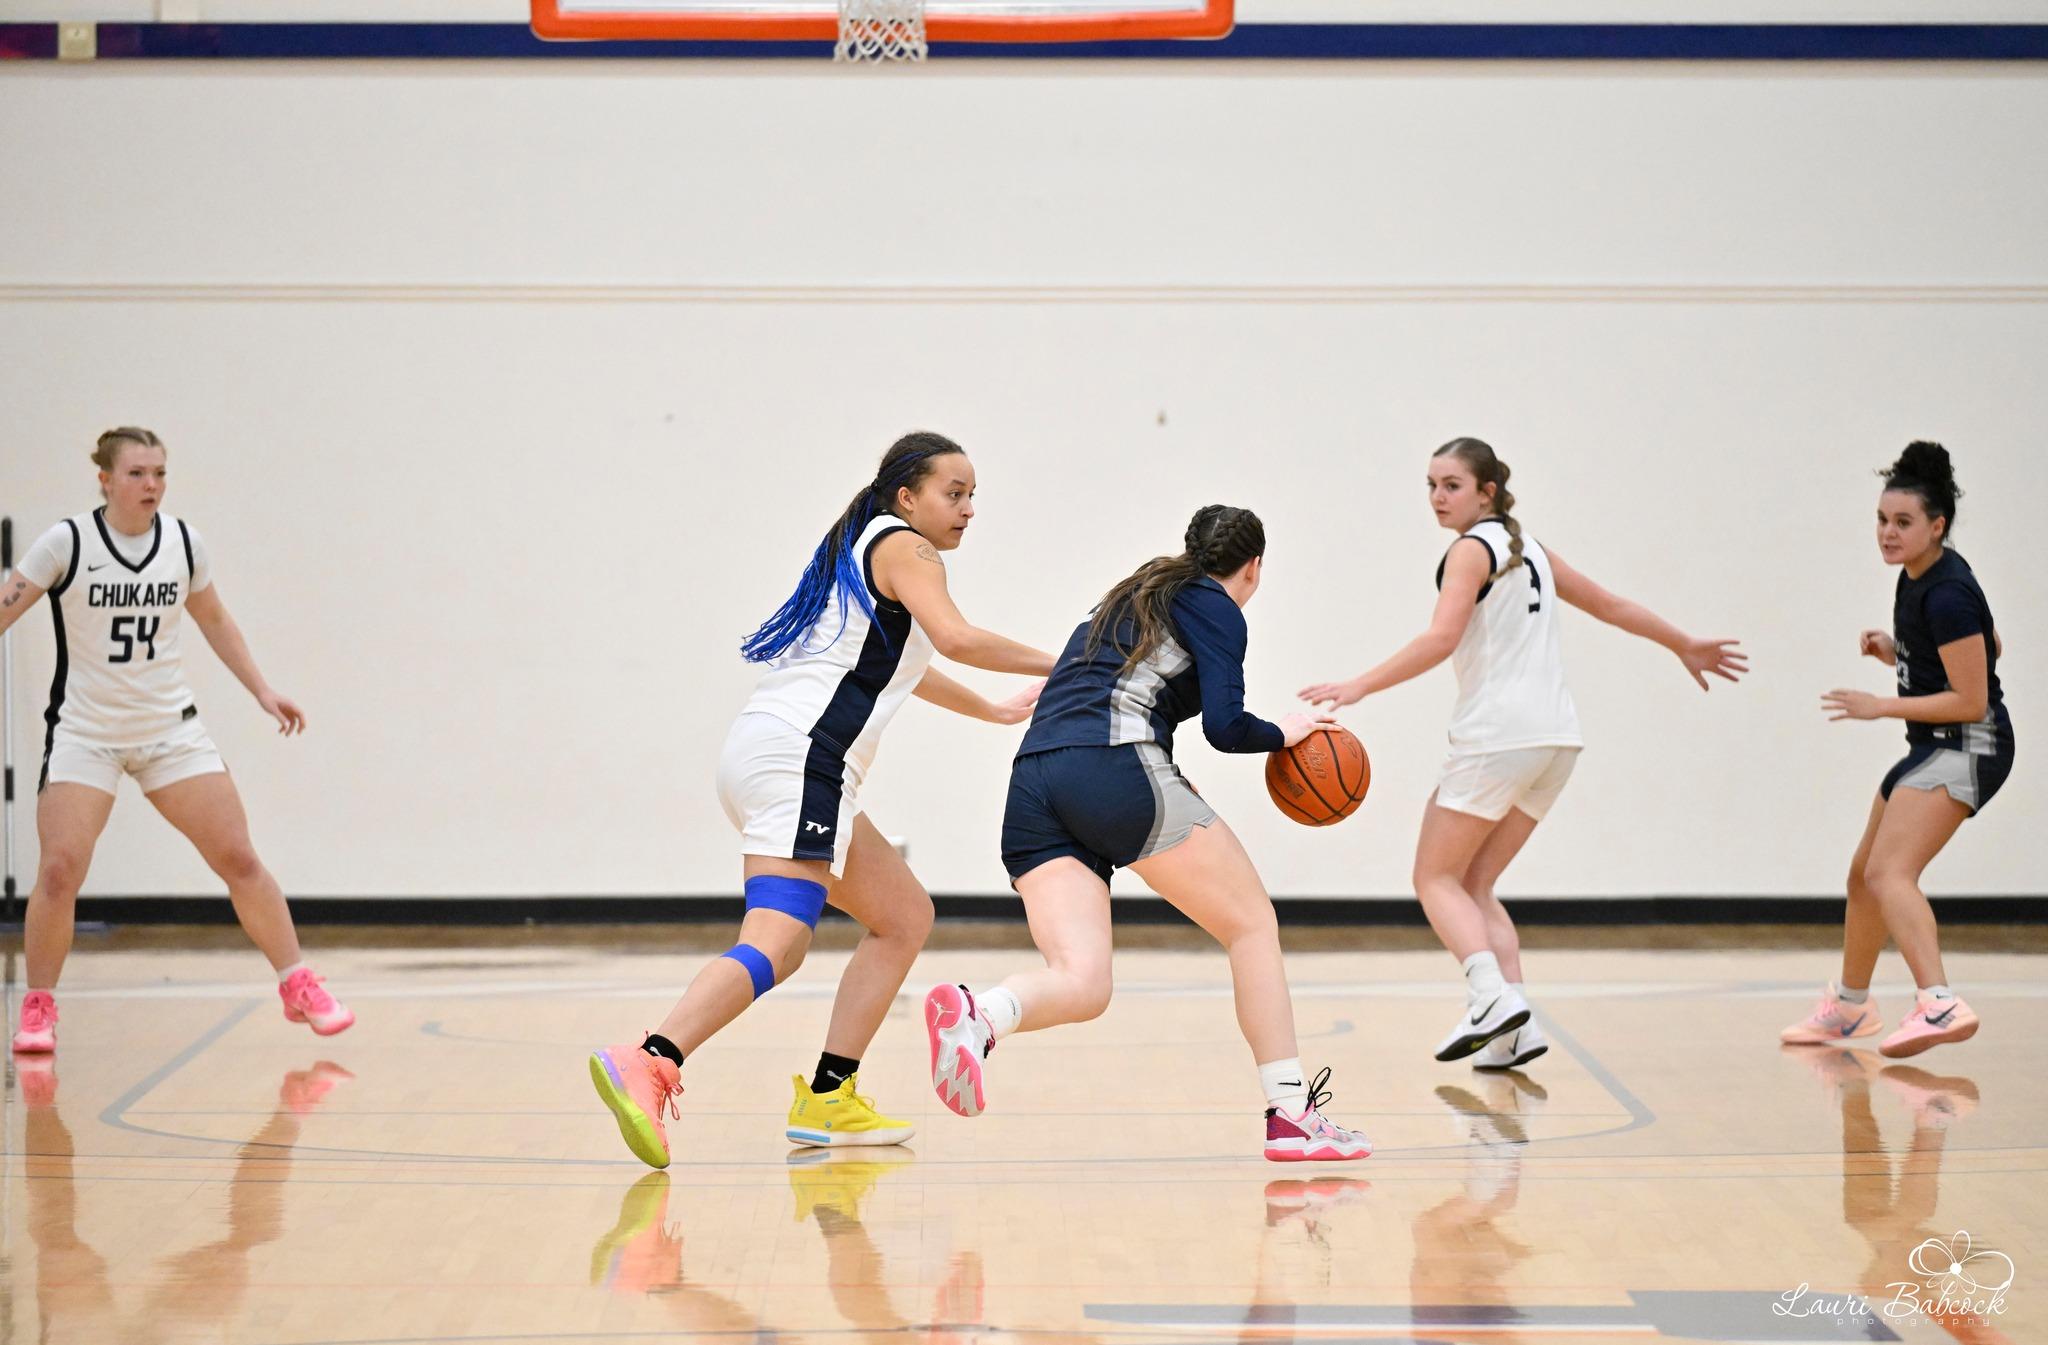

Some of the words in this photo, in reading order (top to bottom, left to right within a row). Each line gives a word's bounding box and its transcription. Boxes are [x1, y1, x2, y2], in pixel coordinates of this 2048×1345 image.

[89, 582, 178, 607] CHUKARS
[108, 616, 160, 663] 54
[805, 821, 830, 834] TV
